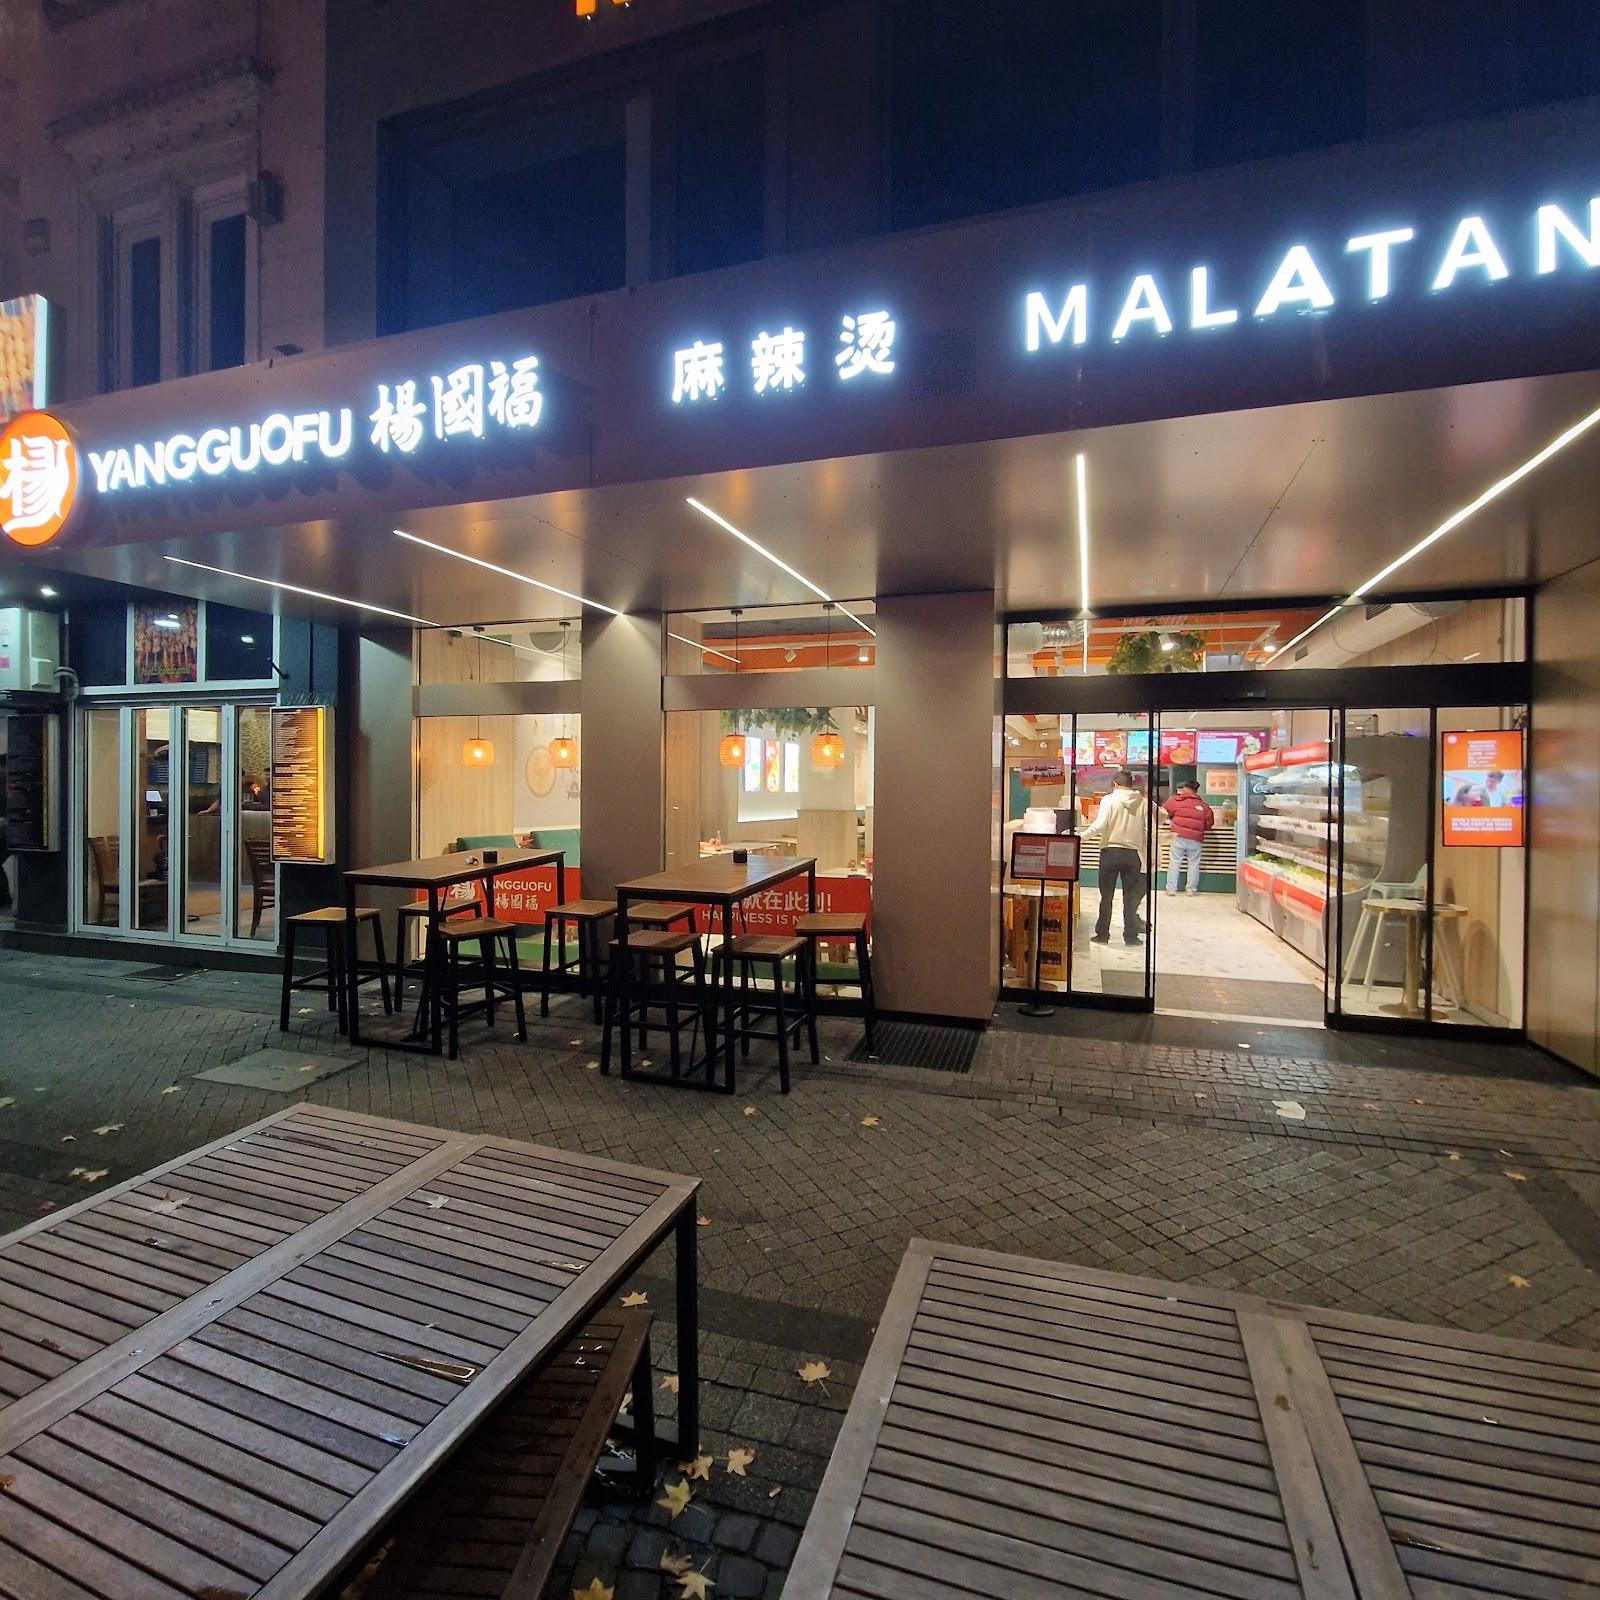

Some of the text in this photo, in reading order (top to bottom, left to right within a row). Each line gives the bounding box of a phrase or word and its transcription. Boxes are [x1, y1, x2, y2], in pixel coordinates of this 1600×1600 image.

[672, 309, 898, 405] 麻辣烫
[370, 355, 543, 455] 楊國福
[88, 408, 353, 494] YANGGUOFU
[482, 879, 552, 892] NGGUOFU
[776, 914, 788, 925] IS
